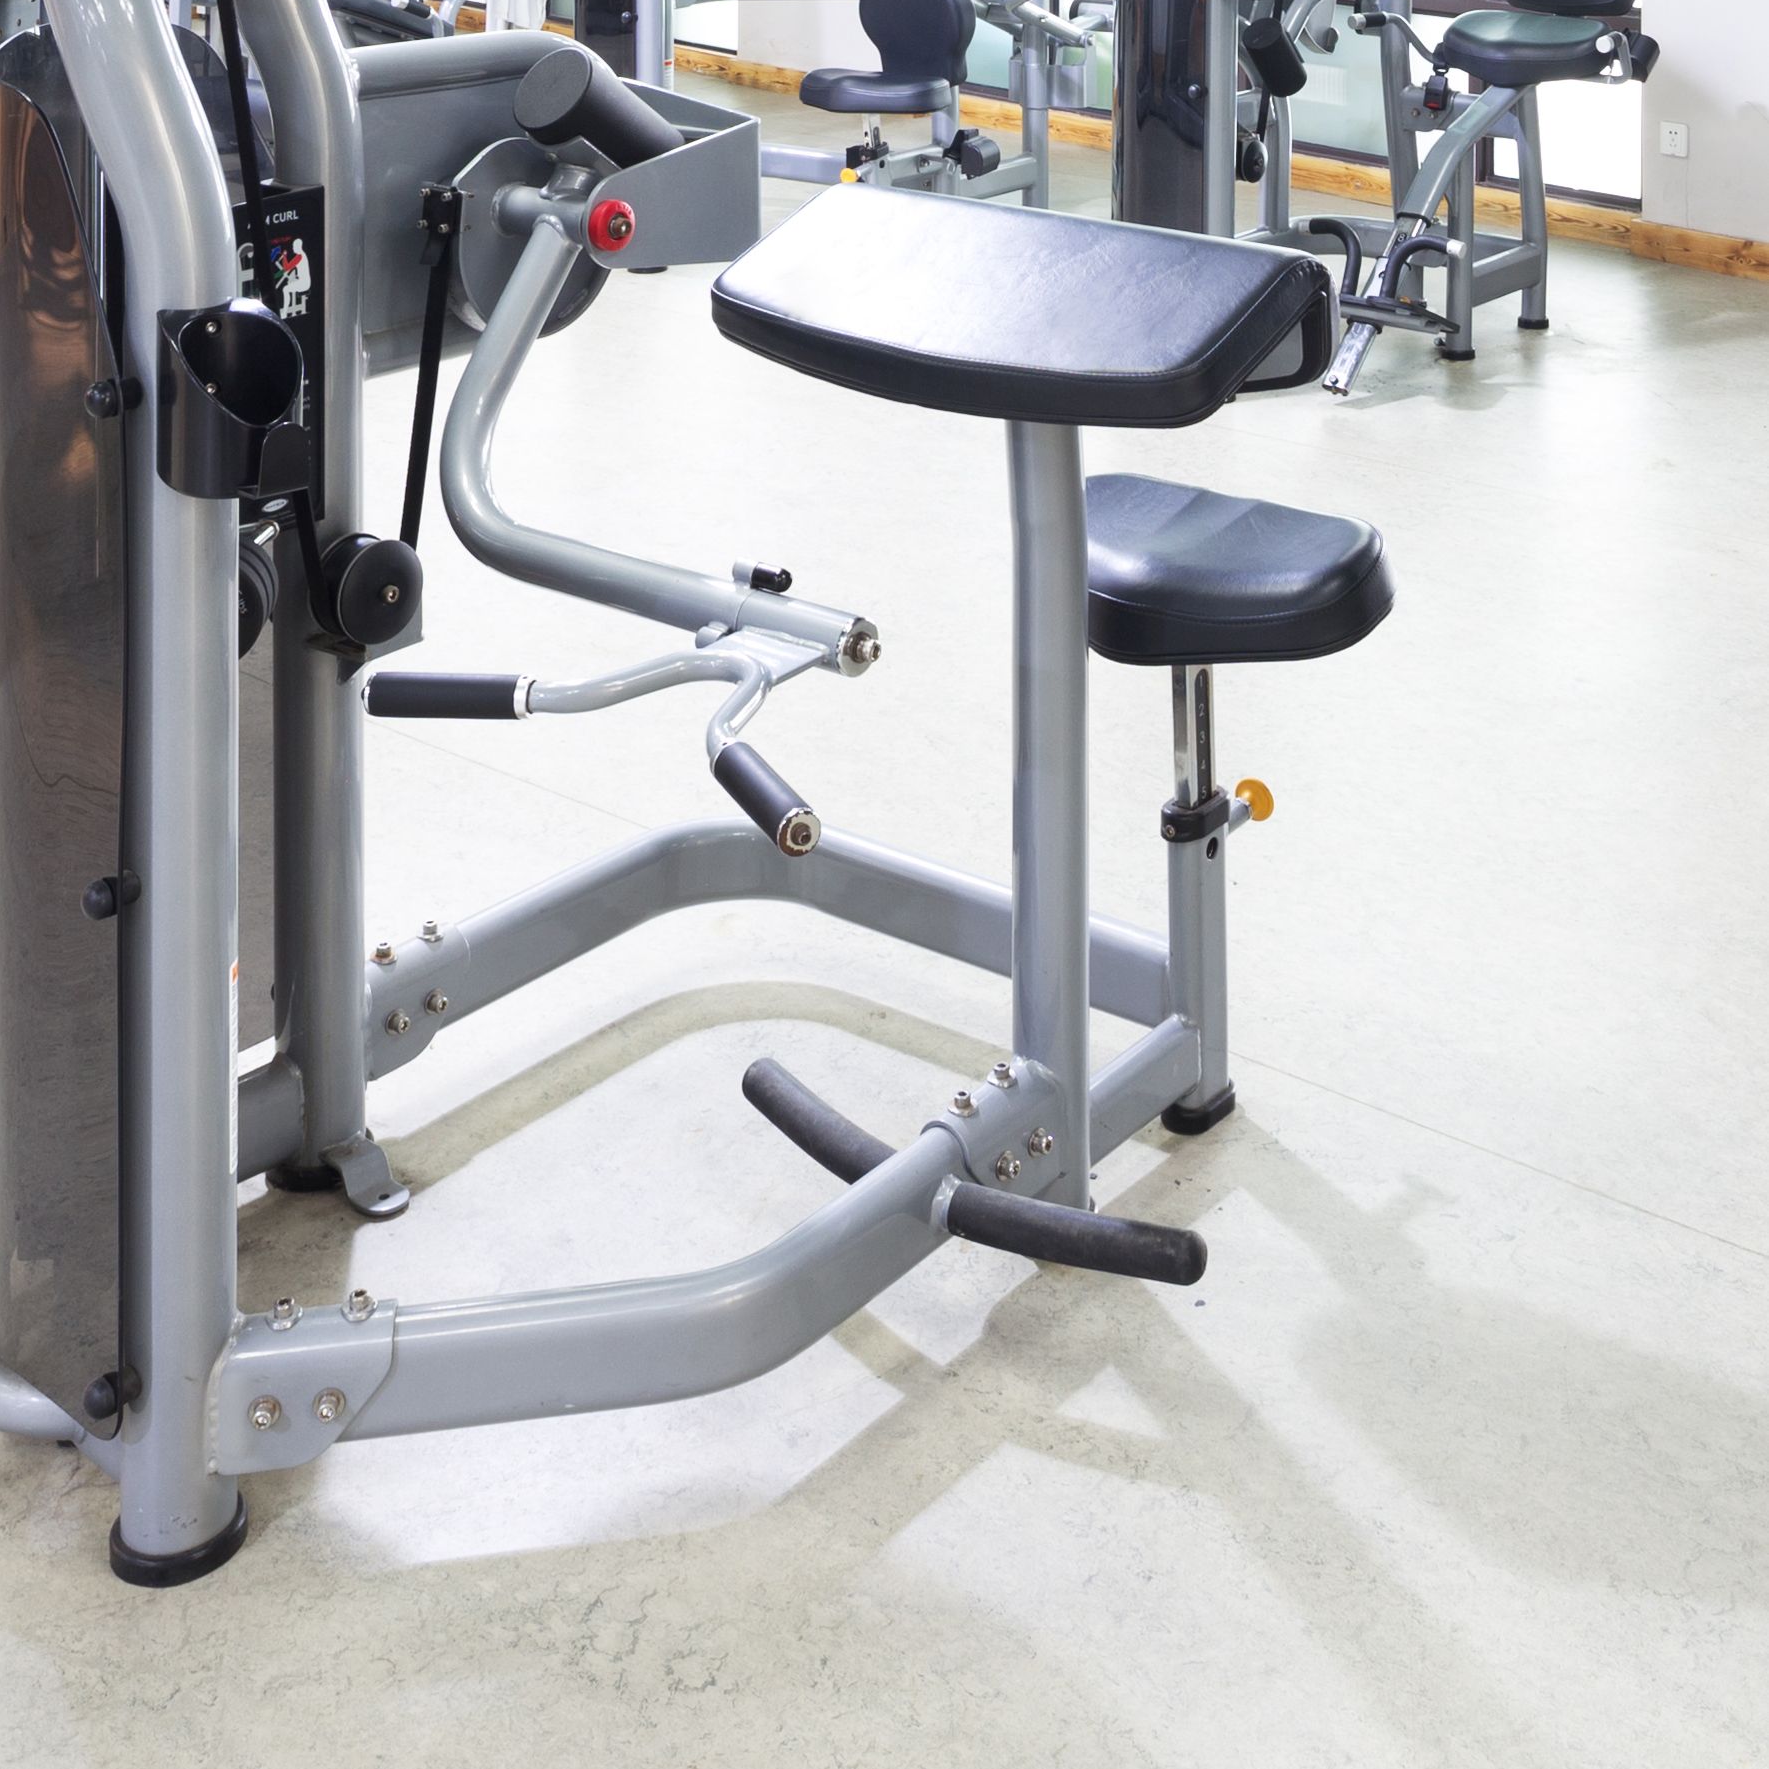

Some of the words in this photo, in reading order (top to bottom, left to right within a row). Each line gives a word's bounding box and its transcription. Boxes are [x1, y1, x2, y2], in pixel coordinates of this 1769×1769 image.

[272, 210, 299, 224] CURL
[1199, 704, 1205, 717] 2
[1200, 731, 1205, 744] 3
[1201, 786, 1207, 799] 5
